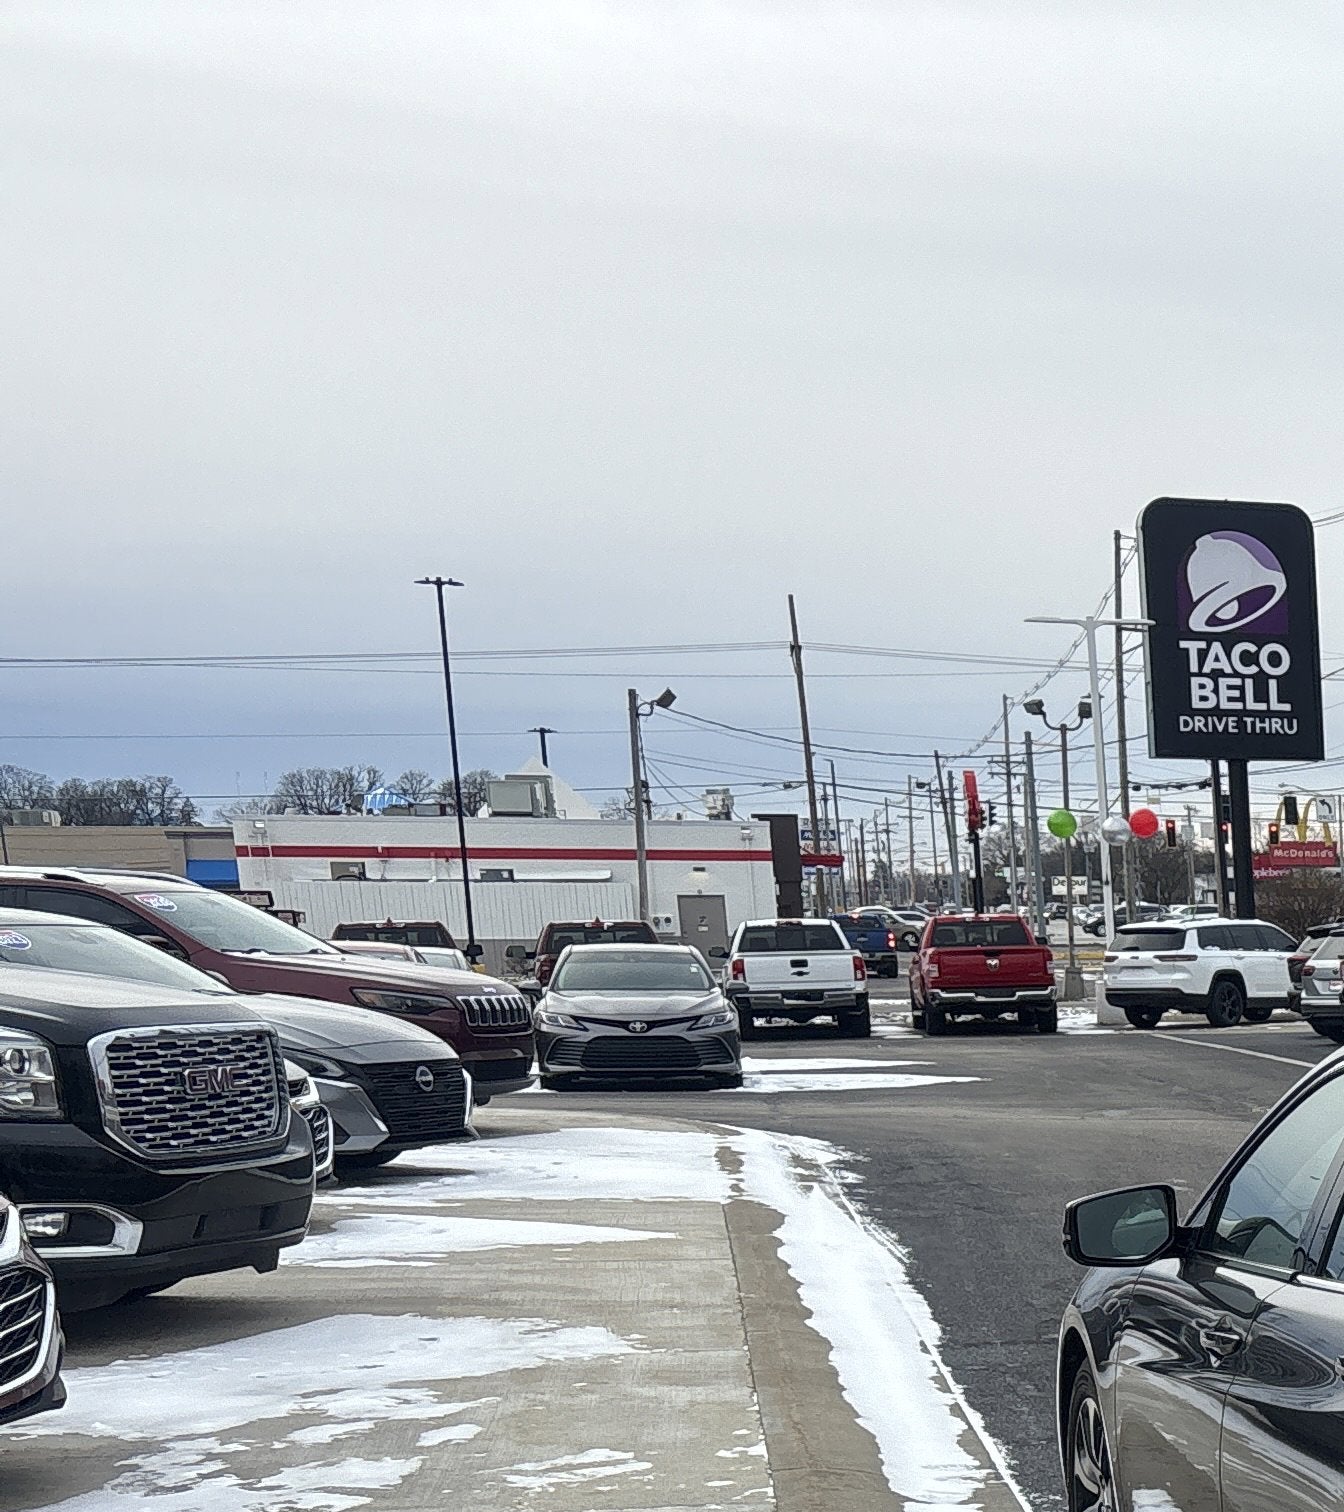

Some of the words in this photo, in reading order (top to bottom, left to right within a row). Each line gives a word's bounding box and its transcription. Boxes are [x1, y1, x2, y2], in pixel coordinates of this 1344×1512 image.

[1179, 640, 1291, 676] TACO
[1190, 677, 1292, 711] BELL
[1179, 716, 1239, 733] DRIVE
[1243, 717, 1298, 735] THRU
[1273, 849, 1334, 857] McDonald's
[1052, 877, 1087, 886] Deour
[184, 1066, 248, 1095] GMC
